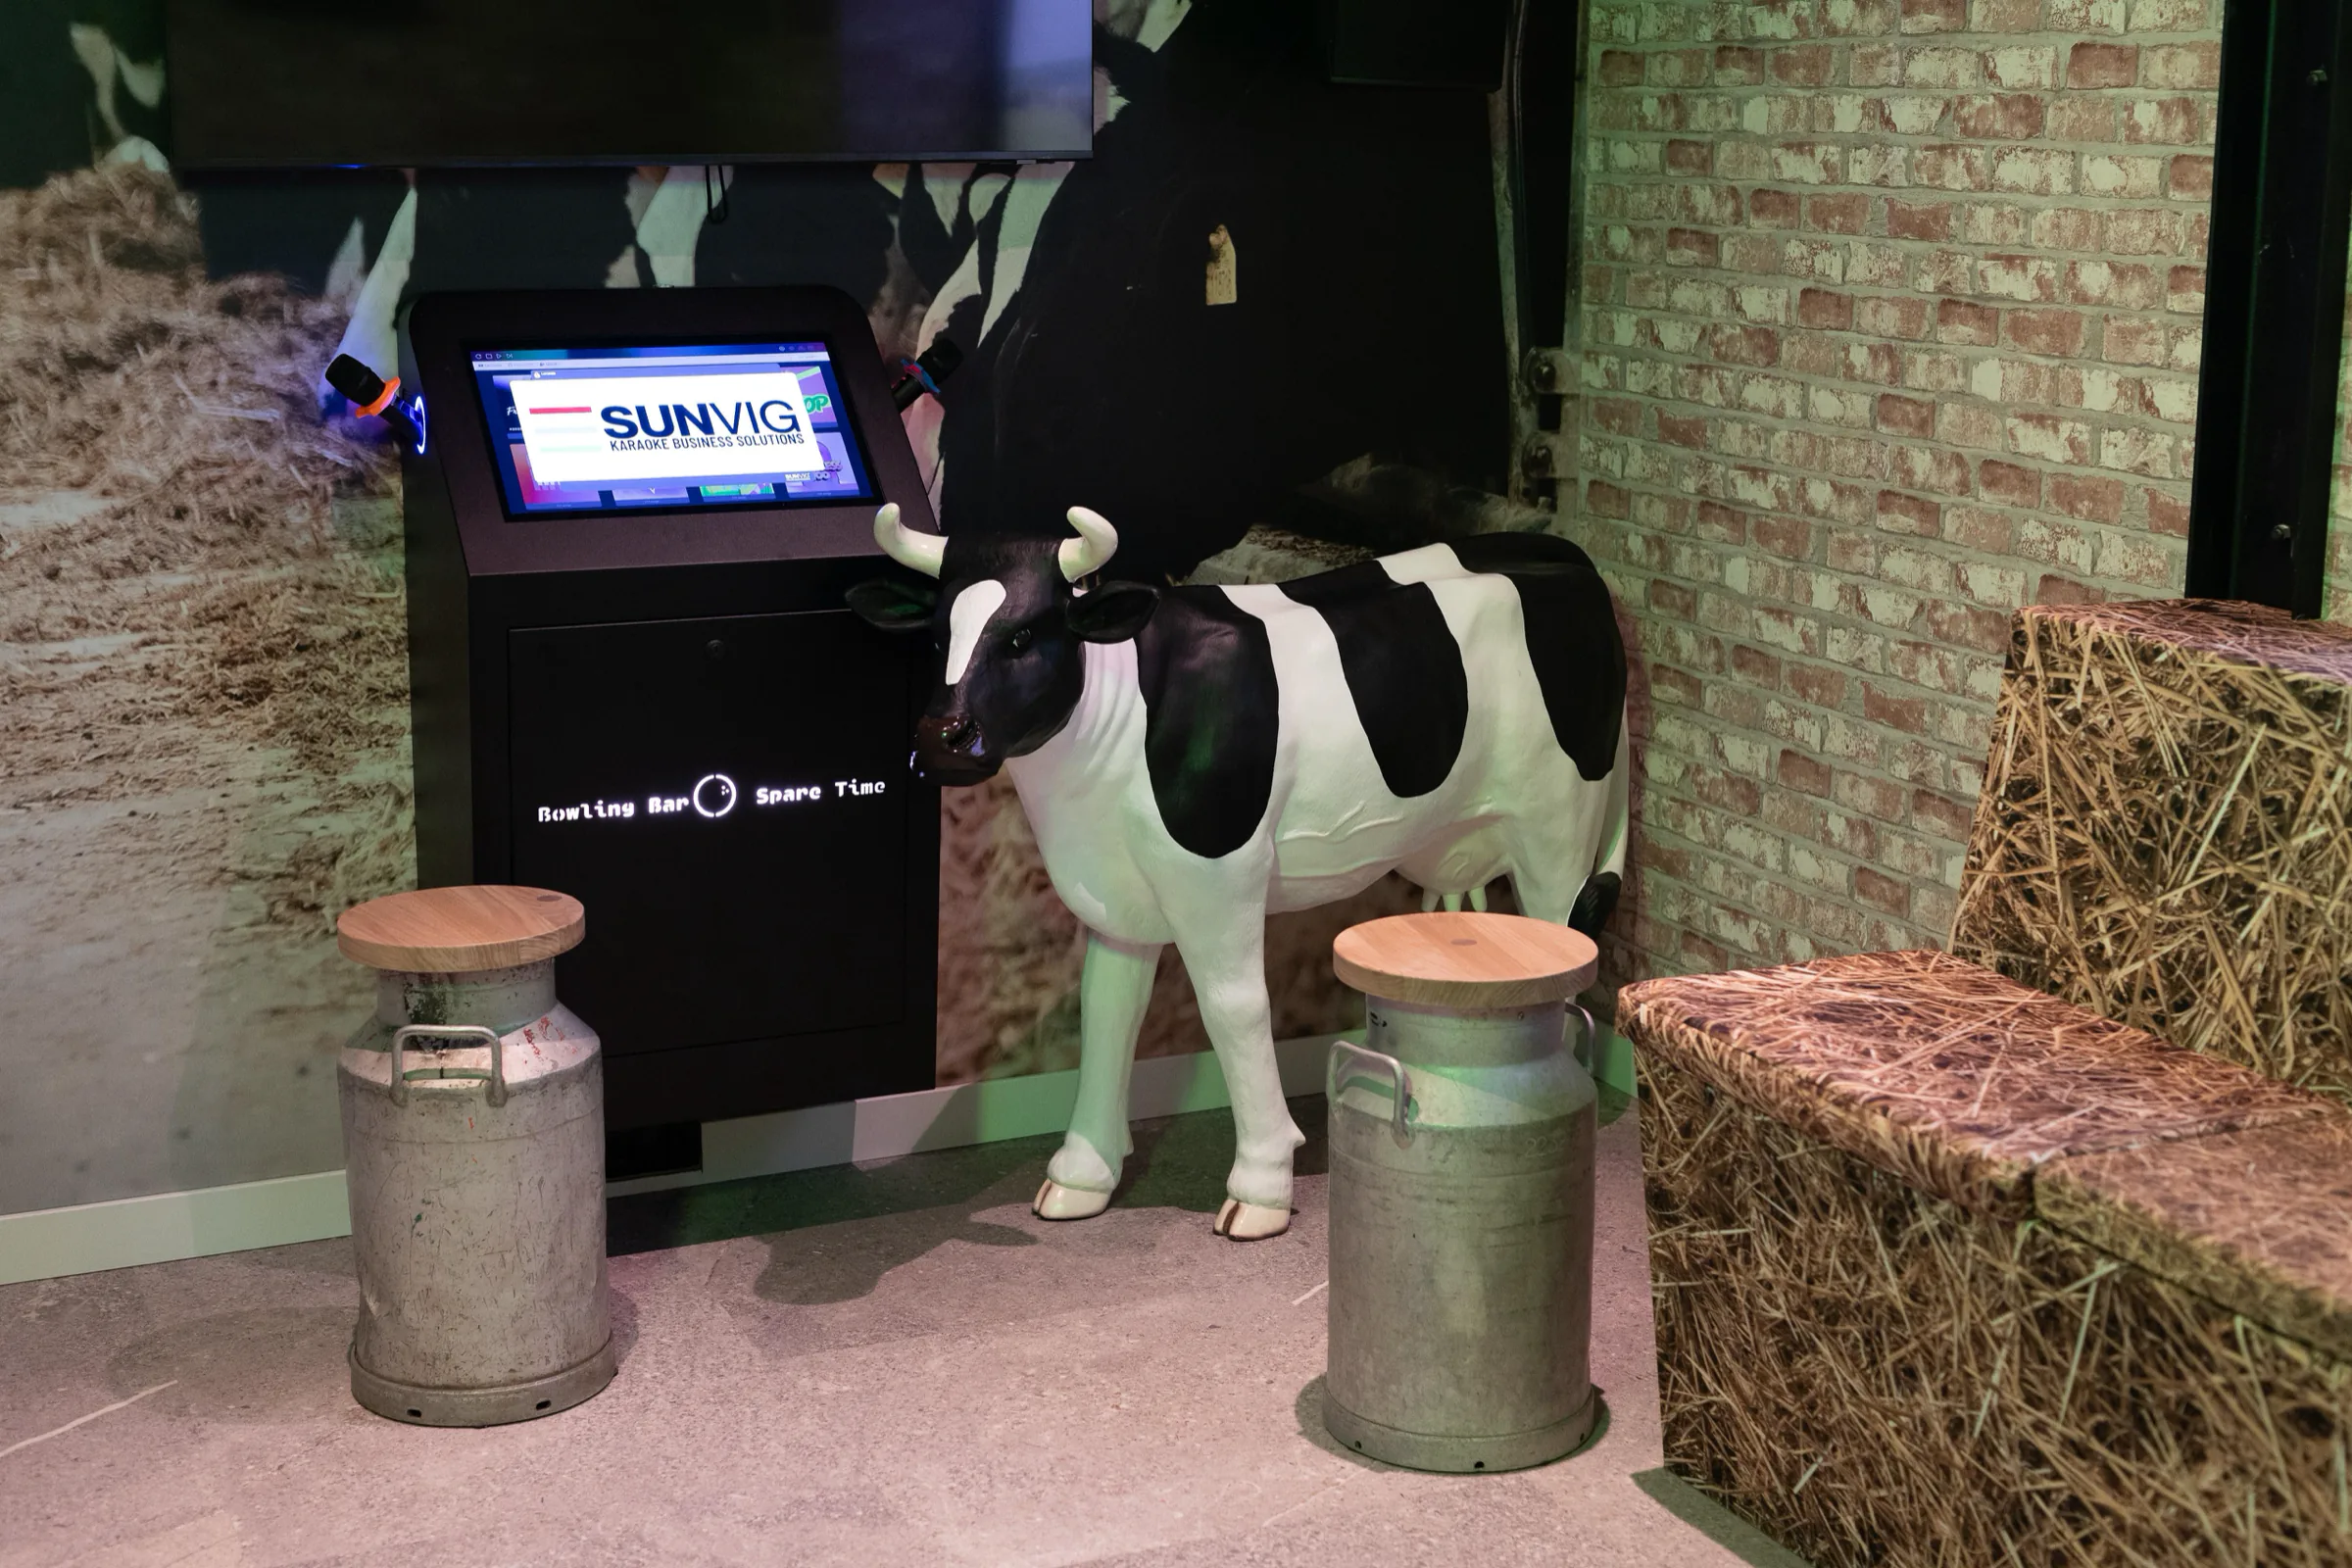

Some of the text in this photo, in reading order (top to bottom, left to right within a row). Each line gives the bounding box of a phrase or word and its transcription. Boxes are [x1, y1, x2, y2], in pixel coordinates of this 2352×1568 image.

[600, 399, 802, 440] SUNVIG
[610, 433, 805, 452] KARAOKE BUSINESS SOLUTIONS
[537, 778, 886, 823] Bowling Bar Spare Time
